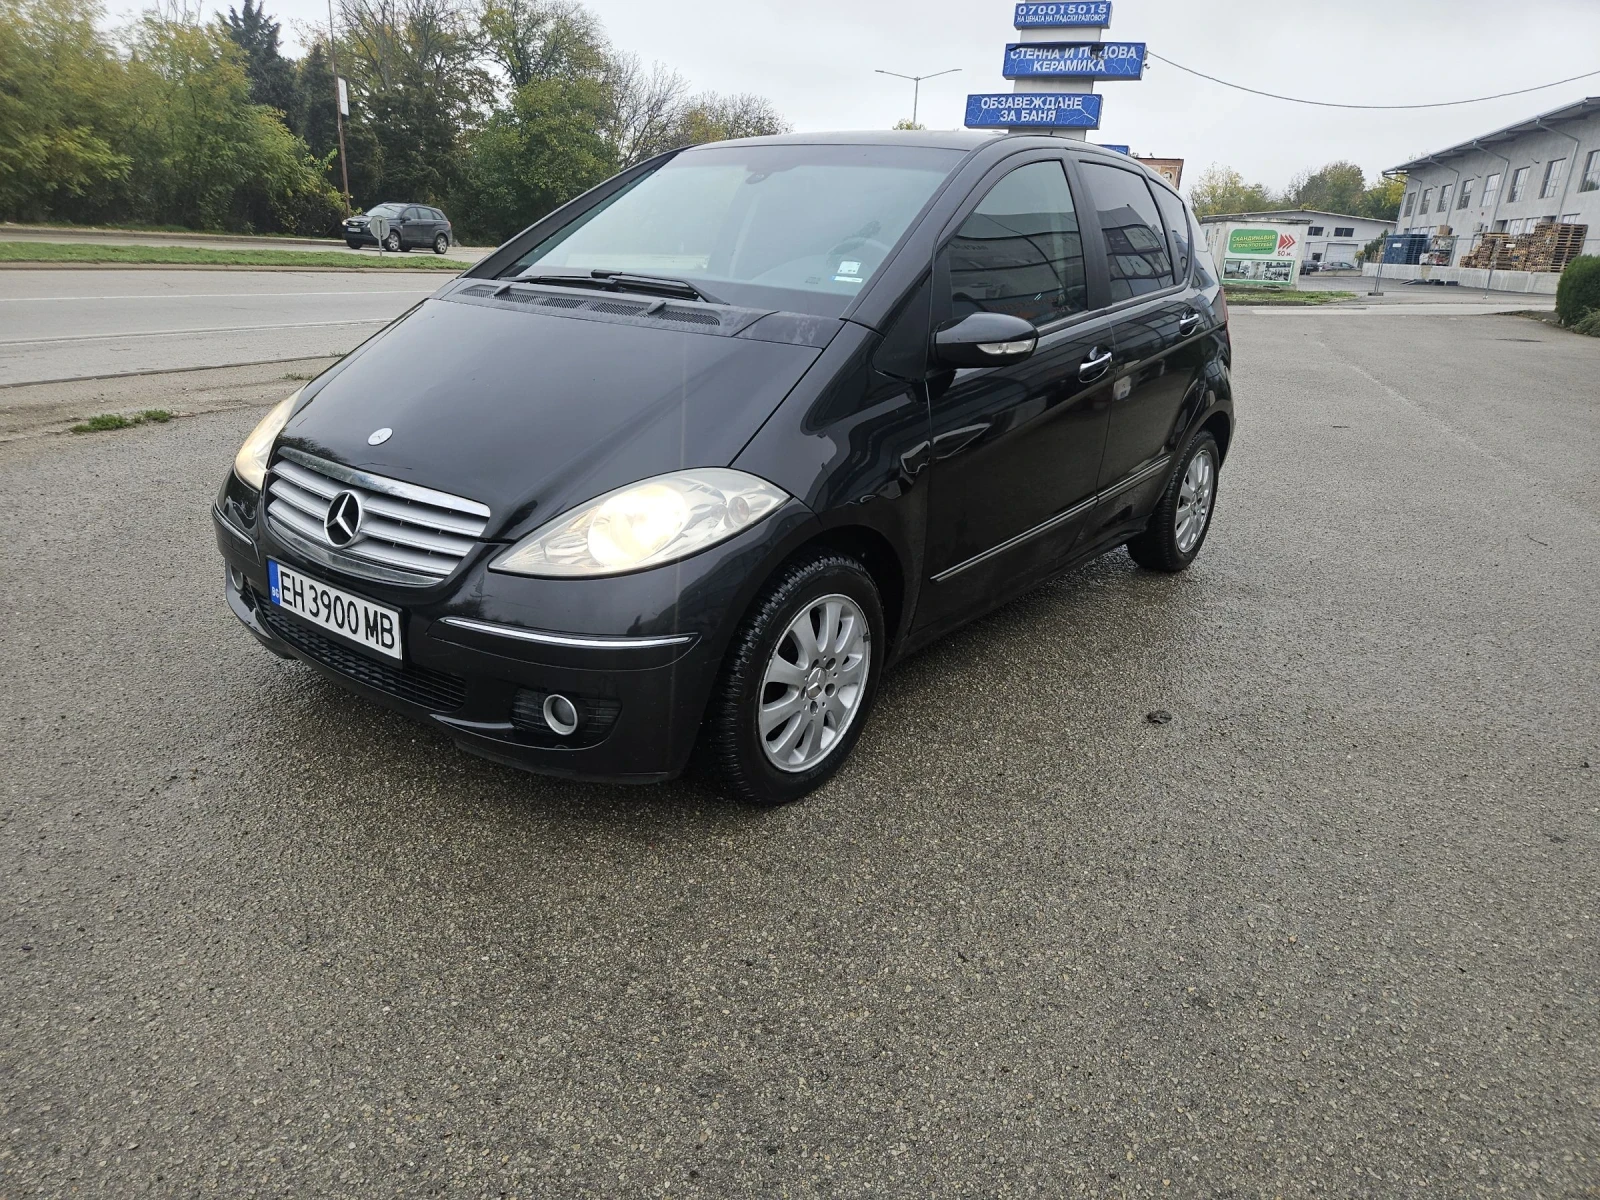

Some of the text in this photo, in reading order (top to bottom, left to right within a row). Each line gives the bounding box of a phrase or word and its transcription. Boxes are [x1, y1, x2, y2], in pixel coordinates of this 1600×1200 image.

[1018, 4, 1107, 15] 070015015
[1026, 15, 1045, 23] ЦЕНАТА
[1053, 14, 1078, 22] ГРАДСКИ
[1010, 45, 1137, 59] СТЕННА И ПДОВА
[1033, 60, 1106, 72] КЕРАМИКА
[981, 97, 1083, 109] ОБЗАВЕЖДАНЕ
[1000, 110, 1057, 121] ЗА БАНЯ
[271, 587, 280, 598] BG
